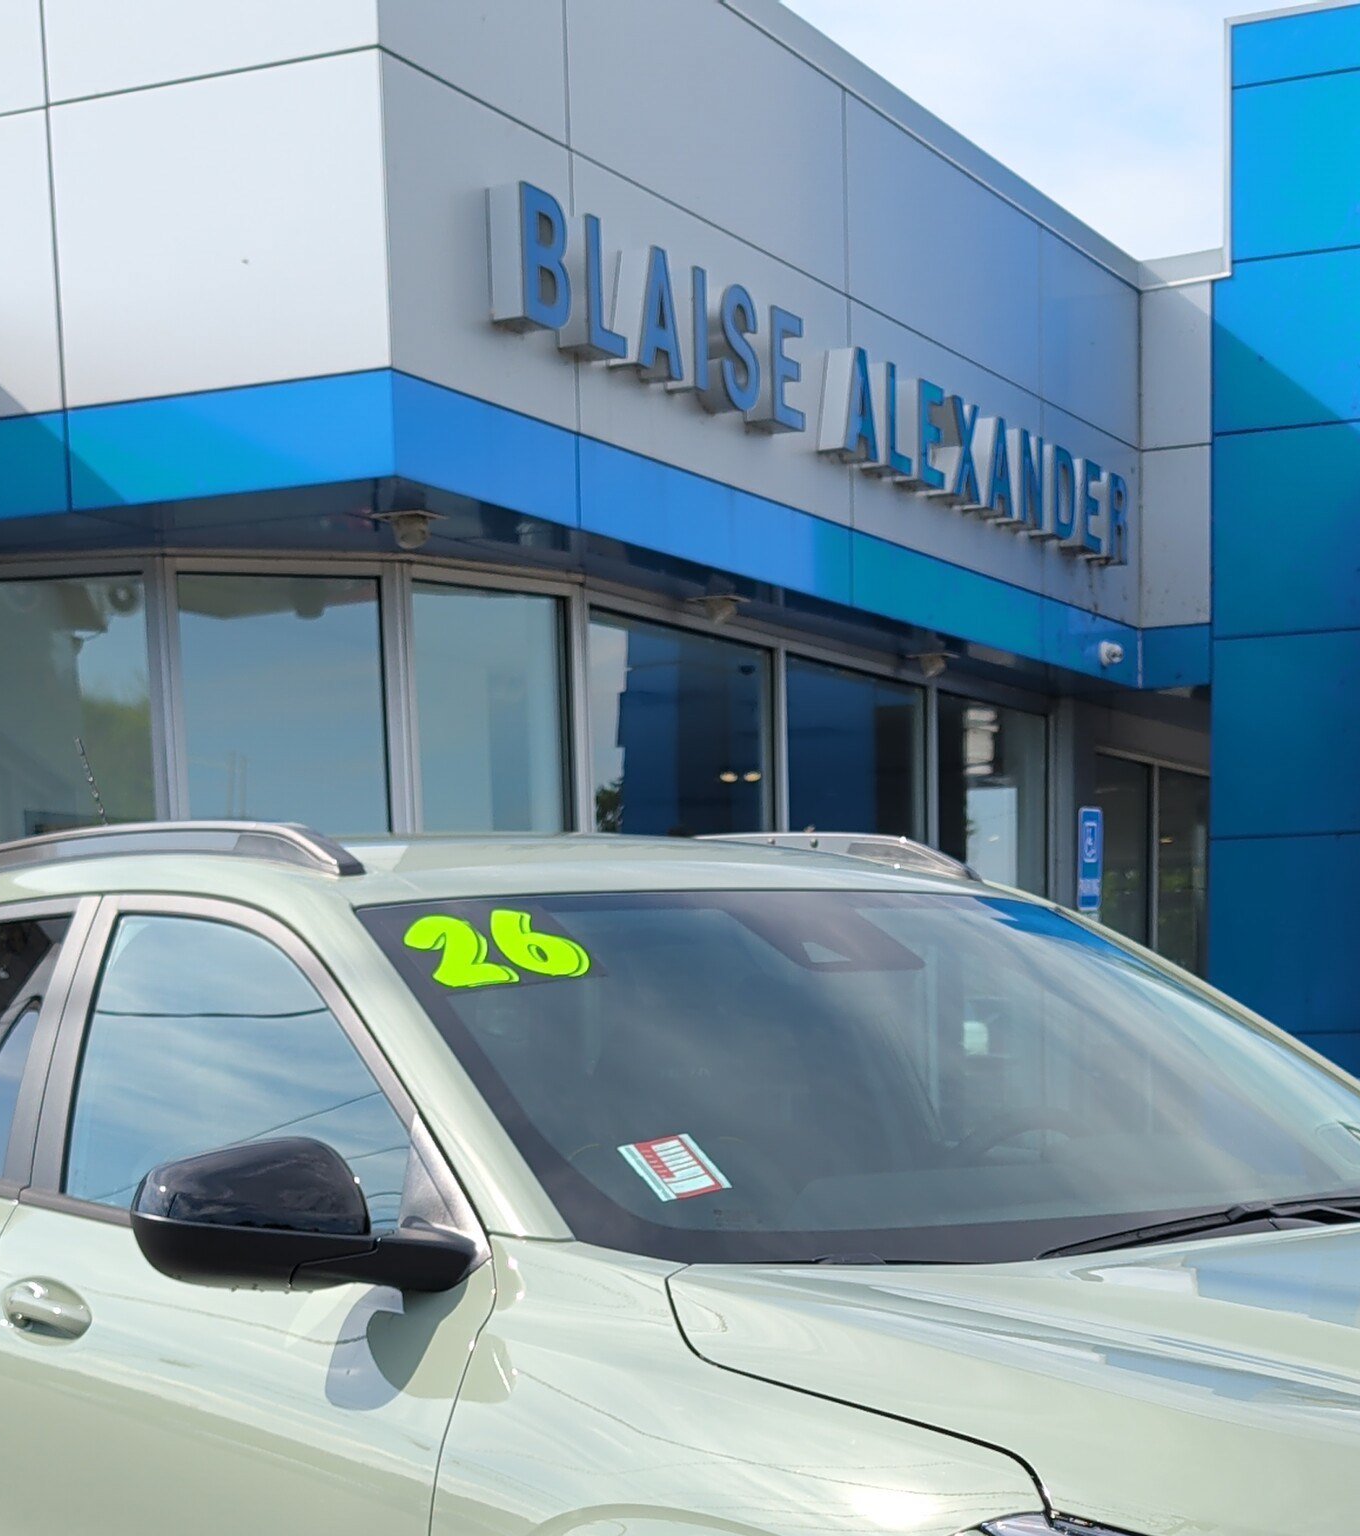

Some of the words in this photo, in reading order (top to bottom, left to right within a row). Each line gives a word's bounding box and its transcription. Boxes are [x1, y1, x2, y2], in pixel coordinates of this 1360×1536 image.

[518, 179, 808, 436] BLAISE
[844, 345, 1131, 568] ALEXANDER
[402, 905, 591, 988] 26
